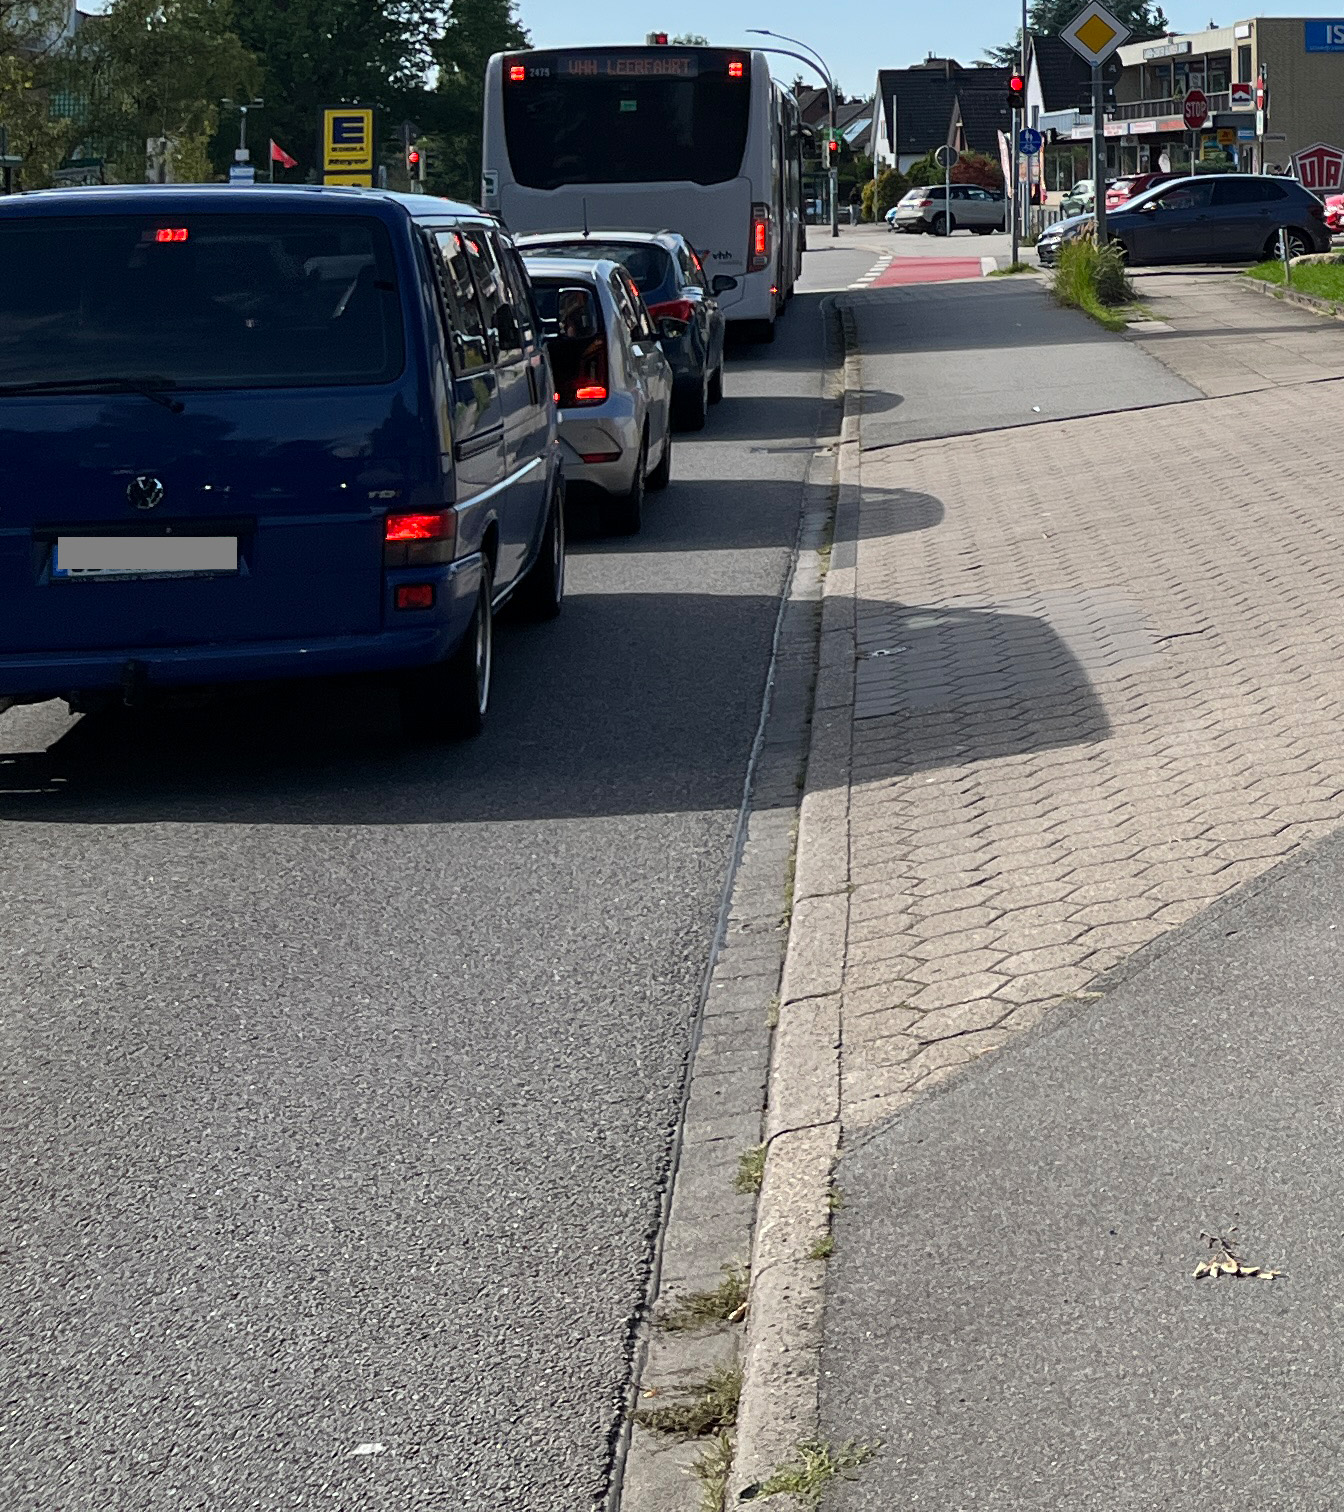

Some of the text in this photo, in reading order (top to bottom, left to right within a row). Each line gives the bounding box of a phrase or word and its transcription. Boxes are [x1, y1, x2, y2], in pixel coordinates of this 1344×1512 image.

[607, 58, 691, 76] LEERFAHRT
[1185, 101, 1207, 119] STOP
[1299, 148, 1342, 188] UTA
